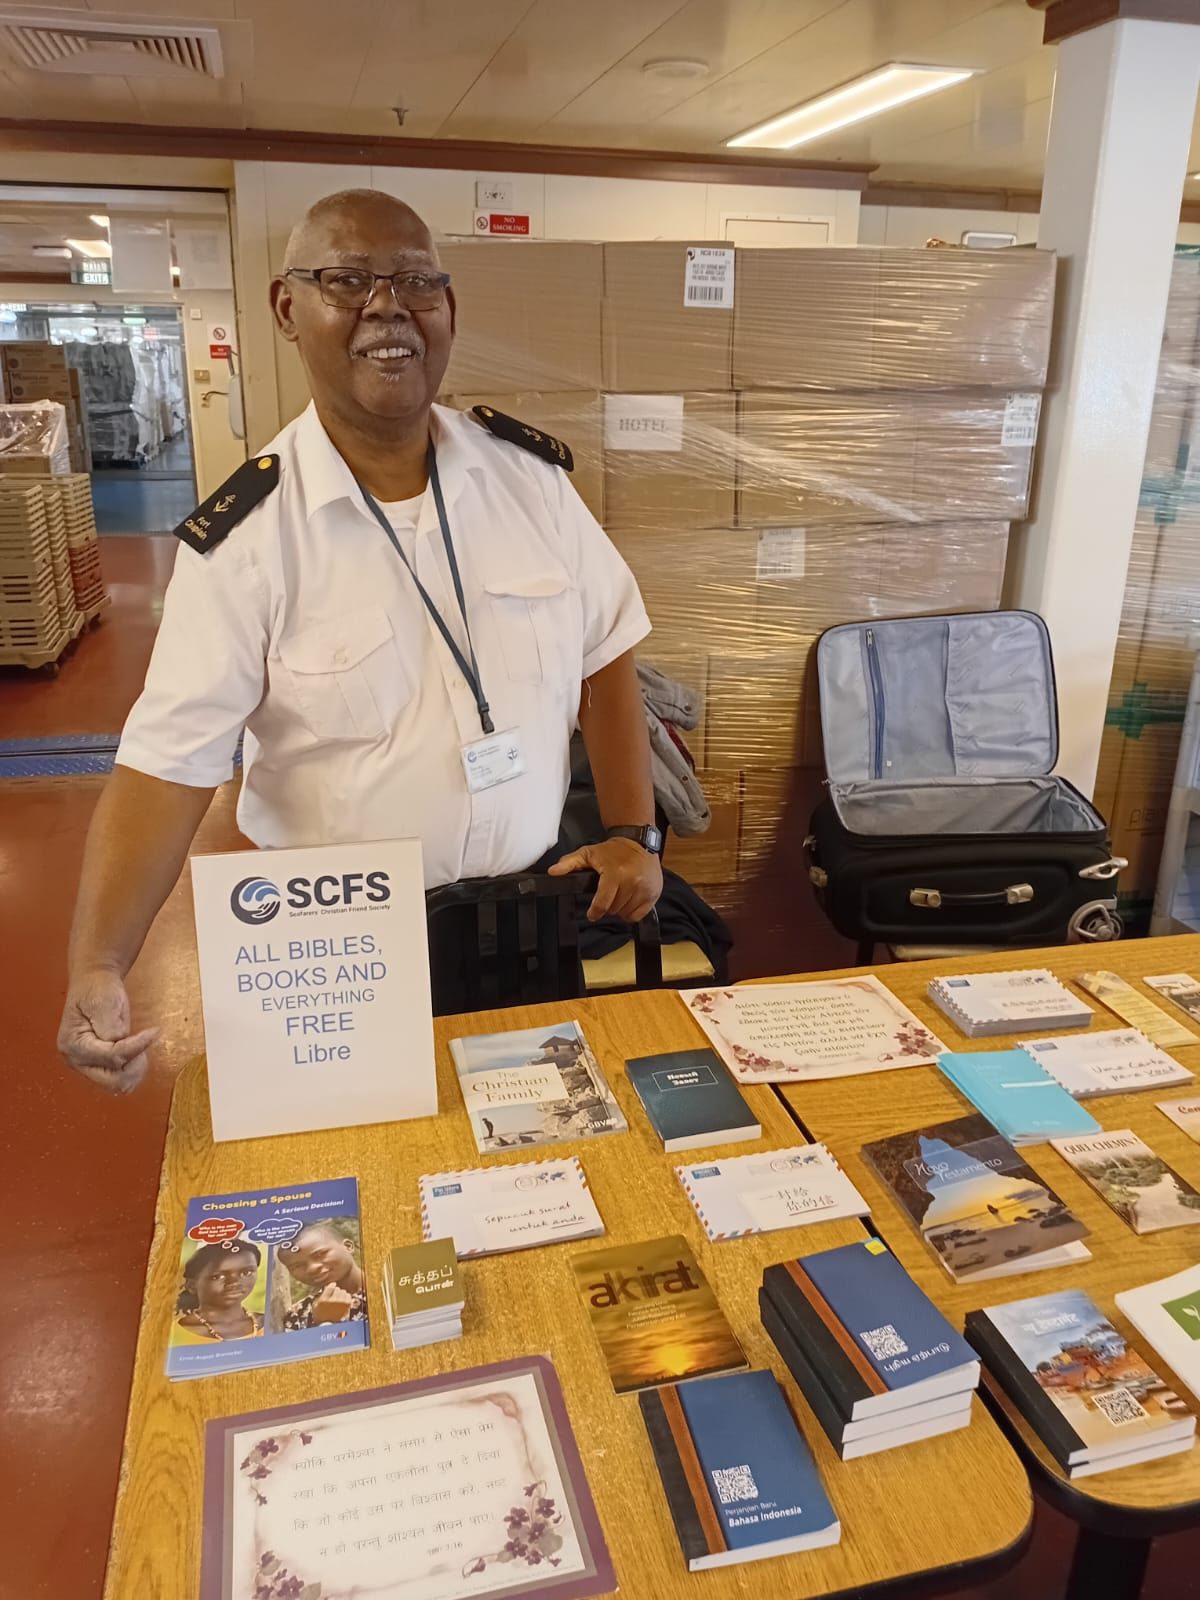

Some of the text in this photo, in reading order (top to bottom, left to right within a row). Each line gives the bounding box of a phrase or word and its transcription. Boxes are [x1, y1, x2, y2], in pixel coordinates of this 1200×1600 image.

[493, 224, 527, 232] SMOKING
[619, 418, 669, 432] HOTEL
[286, 871, 391, 909] SCFS
[368, 903, 391, 911] Society
[234, 934, 382, 966] ALL BIBLES,
[236, 961, 388, 994] BOOKS AND
[261, 988, 376, 1012] EVERYTHING
[285, 1011, 356, 1037] FREE
[293, 1044, 352, 1066] Libre
[472, 1077, 549, 1092] Christian
[486, 1089, 543, 1102] Family
[914, 1162, 949, 1177] Novo
[934, 1158, 1002, 1182] Testamento
[202, 1200, 257, 1211] Choosing
[270, 1192, 312, 1204] Spouse
[282, 1206, 309, 1214] Serious
[310, 1200, 344, 1209] Decision!
[399, 1265, 453, 1286] சுத்தப்
[416, 1280, 454, 1294] பொன்
[728, 1506, 803, 1528] Bahasa Indonesia
